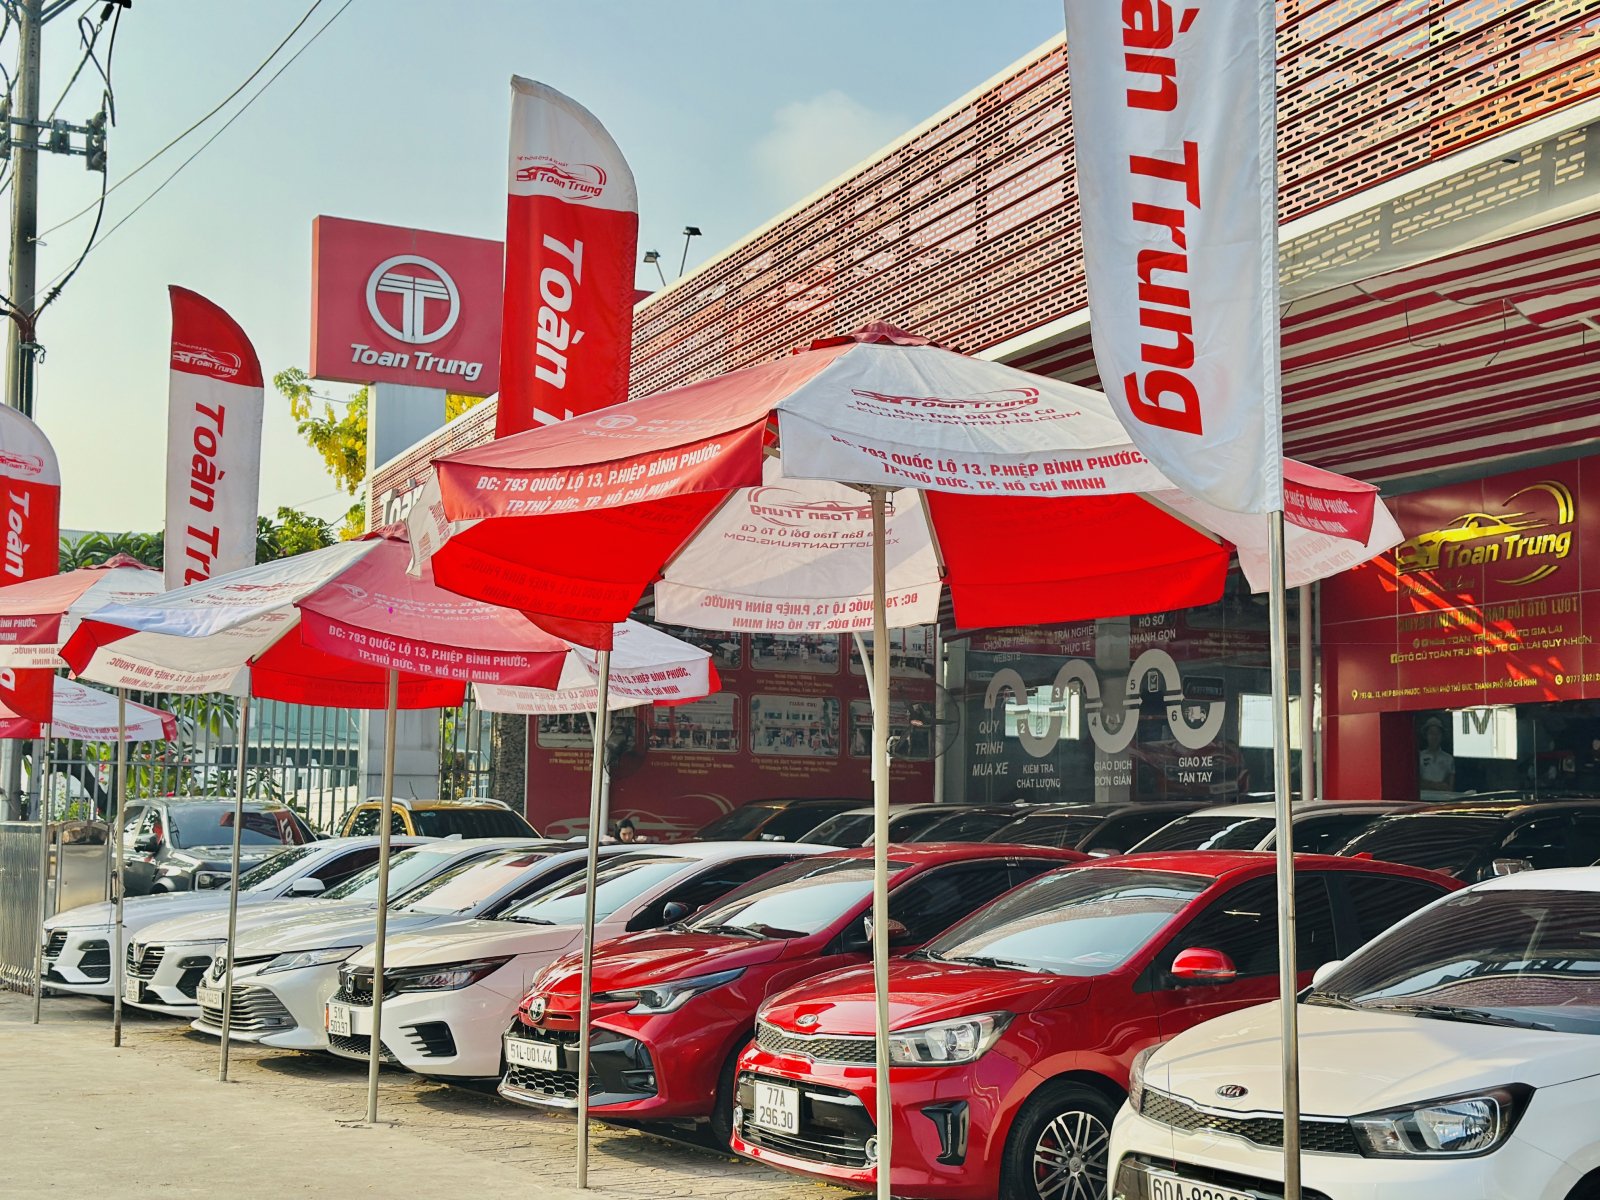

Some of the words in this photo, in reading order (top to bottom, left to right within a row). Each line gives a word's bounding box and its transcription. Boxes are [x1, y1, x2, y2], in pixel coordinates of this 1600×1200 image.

[539, 172, 566, 189] Toan
[568, 181, 602, 197] Trung
[1123, 140, 1203, 436] Trung
[535, 233, 585, 390] Toàn
[214, 362, 239, 376] Trung
[350, 343, 410, 368] Toan
[414, 351, 483, 382] Trung
[905, 400, 965, 409] Toan
[973, 397, 1039, 409] Trung
[928, 412, 961, 420] Trao
[190, 402, 225, 513] Toàn
[857, 445, 888, 460] 793
[891, 453, 933, 470] QUỐC
[937, 459, 957, 475] LỘ
[961, 463, 987, 477] 13,
[990, 462, 1039, 479] P.HIỆP
[1043, 459, 1084, 475] BÌNH
[1086, 450, 1148, 470] PHƯỚC,
[476, 475, 501, 491] ĐC:
[504, 478, 527, 492] 793
[529, 472, 566, 493] QUỐC
[567, 473, 584, 492] LỘ
[586, 473, 604, 488] 13,
[606, 467, 647, 488] P.HIỆP
[647, 455, 679, 477] BÌNH
[935, 474, 975, 489] ĐỨC,
[976, 480, 1000, 490] TP.
[1002, 479, 1026, 491] HỒ
[1029, 480, 1057, 492] CHÍ
[1061, 477, 1106, 490] MINH
[507, 496, 552, 512] TP.THỦ
[552, 497, 578, 511] ĐỨC,
[583, 494, 602, 509] TP.
[603, 490, 622, 505] HỒ
[623, 485, 648, 502] CHÍ
[4, 490, 30, 578] Toàn
[1445, 541, 1499, 569] Toan
[1503, 531, 1572, 560] Trung
[1128, 631, 1156, 645] NHANH
[1157, 628, 1176, 642] GỌN
[1505, 628, 1529, 639] AUTO
[1531, 626, 1547, 635] GIA
[1548, 624, 1563, 634] LAI
[328, 625, 346, 639] ĐC:
[348, 632, 366, 645] 793
[369, 635, 396, 652] QUỐC
[398, 642, 411, 657] LỘ
[414, 647, 429, 660] 13,
[431, 649, 463, 665] P.HIỆP
[465, 651, 491, 666] BÌNH
[493, 653, 531, 668] PHƯỚC,
[1484, 643, 1507, 653] AUTO
[1510, 642, 1525, 651] GIA
[1527, 640, 1541, 649] LAI
[1542, 639, 1562, 648] QUY
[358, 648, 390, 665] TP.THỦ
[392, 656, 416, 672] ĐỨC,
[418, 663, 433, 674] TP.
[435, 662, 449, 676] HỒ
[451, 666, 469, 680] CHÍ
[472, 670, 500, 681] MINH
[993, 652, 1021, 664] WEBSITE
[1055, 687, 1060, 698] 3
[1130, 679, 1136, 691] 5
[1171, 710, 1178, 722] 6
[978, 720, 1000, 735] QUY
[1020, 723, 1026, 734] 2
[972, 762, 994, 777] MUA
[995, 761, 1008, 775] XE
[1040, 763, 1054, 774] TRA
[1094, 761, 1112, 772] GIAO
[1114, 760, 1133, 773] DỊCH
[1178, 756, 1200, 767] GIAO
[1201, 755, 1213, 767] XE
[1178, 771, 1195, 786] TẬN
[1196, 771, 1213, 783] TAY
[510, 1043, 553, 1065] 51L-001.44
[766, 1087, 786, 1107] 77A
[1218, 1085, 1242, 1097] KIA
[759, 1105, 793, 1130] 296.30
